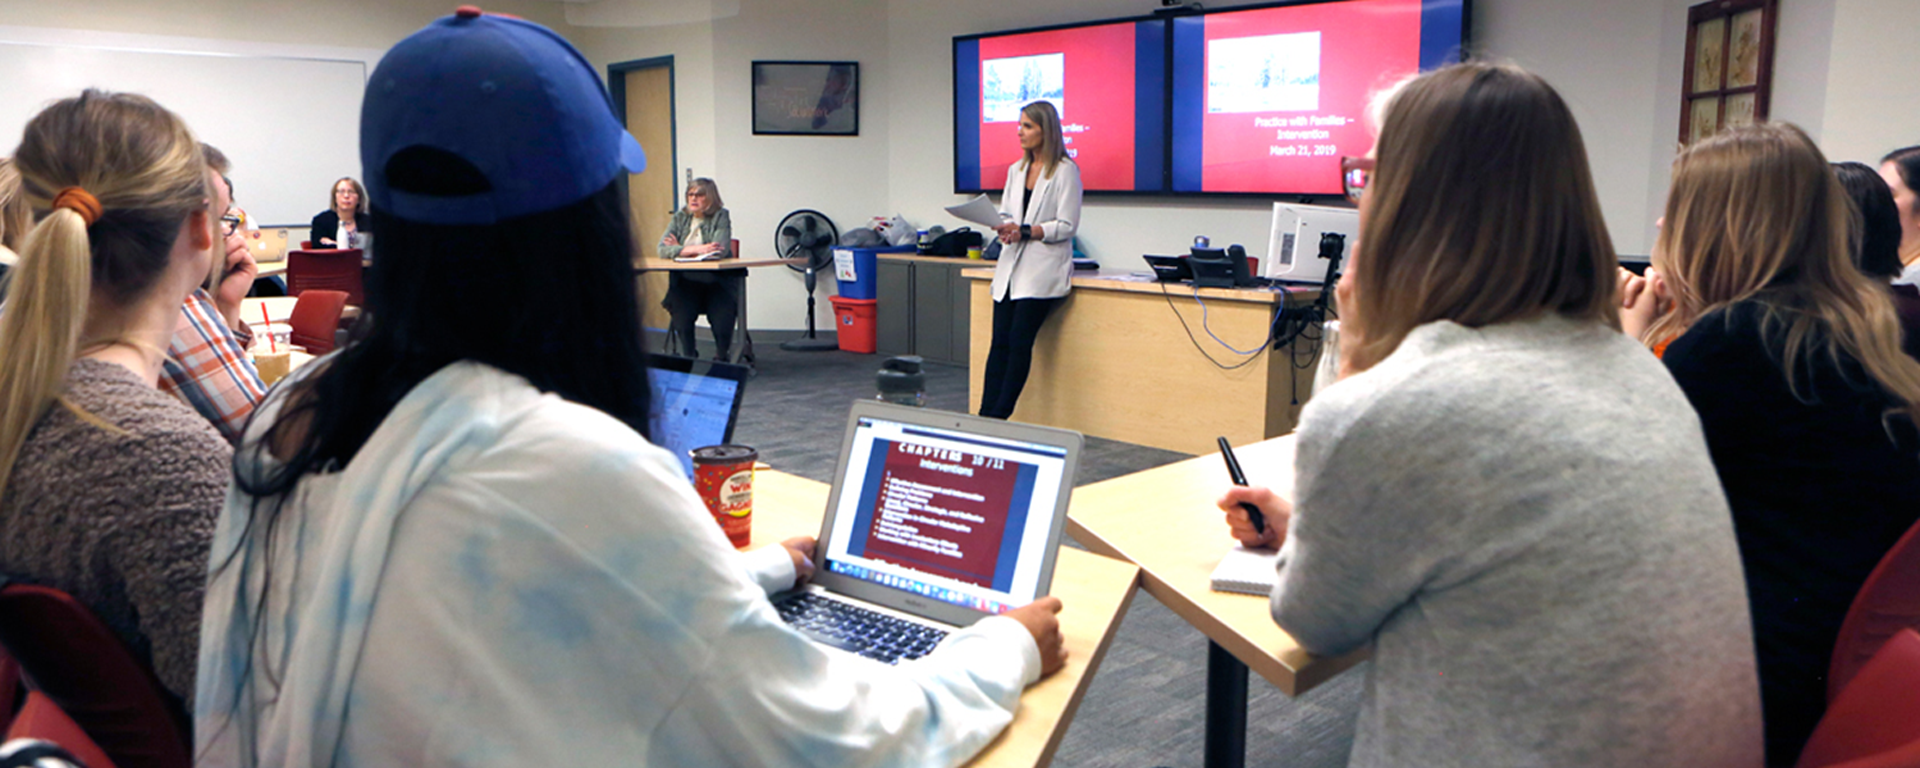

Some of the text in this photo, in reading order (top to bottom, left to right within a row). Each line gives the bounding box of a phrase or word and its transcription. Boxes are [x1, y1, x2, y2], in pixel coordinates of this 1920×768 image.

[1255, 117, 1287, 127] Practice
[1289, 116, 1308, 126] with
[1310, 115, 1346, 126] Families
[1277, 129, 1329, 140] Intervention
[1270, 145, 1296, 155] March
[1314, 144, 1336, 155] 2019
[919, 458, 974, 477] Interventions
